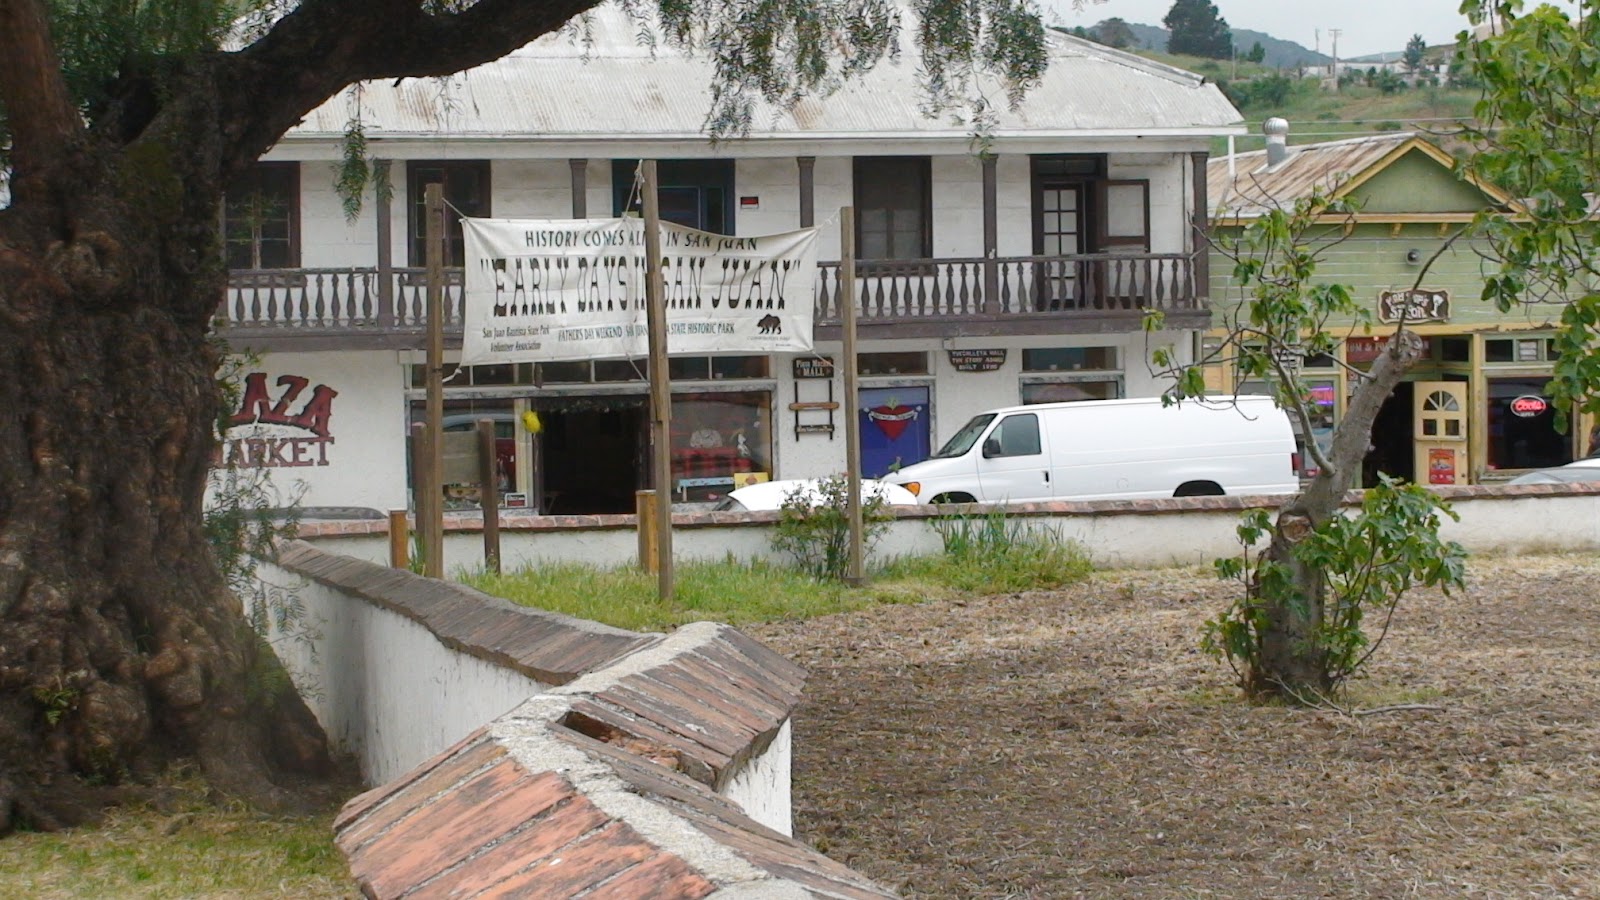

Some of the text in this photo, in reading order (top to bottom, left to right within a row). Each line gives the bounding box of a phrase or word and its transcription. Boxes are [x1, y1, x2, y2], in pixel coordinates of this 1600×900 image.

[525, 230, 578, 248] HISTORY
[666, 232, 680, 246] IN
[684, 232, 711, 247] SAN
[714, 237, 757, 255] JUAN
[577, 256, 628, 313] DAYS
[482, 327, 493, 339] San
[595, 325, 623, 339] WEEKEND
[671, 322, 687, 335] STATE
[687, 321, 717, 335] HISTORIC
[717, 321, 735, 334] PARK
[802, 367, 825, 377] MALL
[229, 372, 338, 436] AZA
